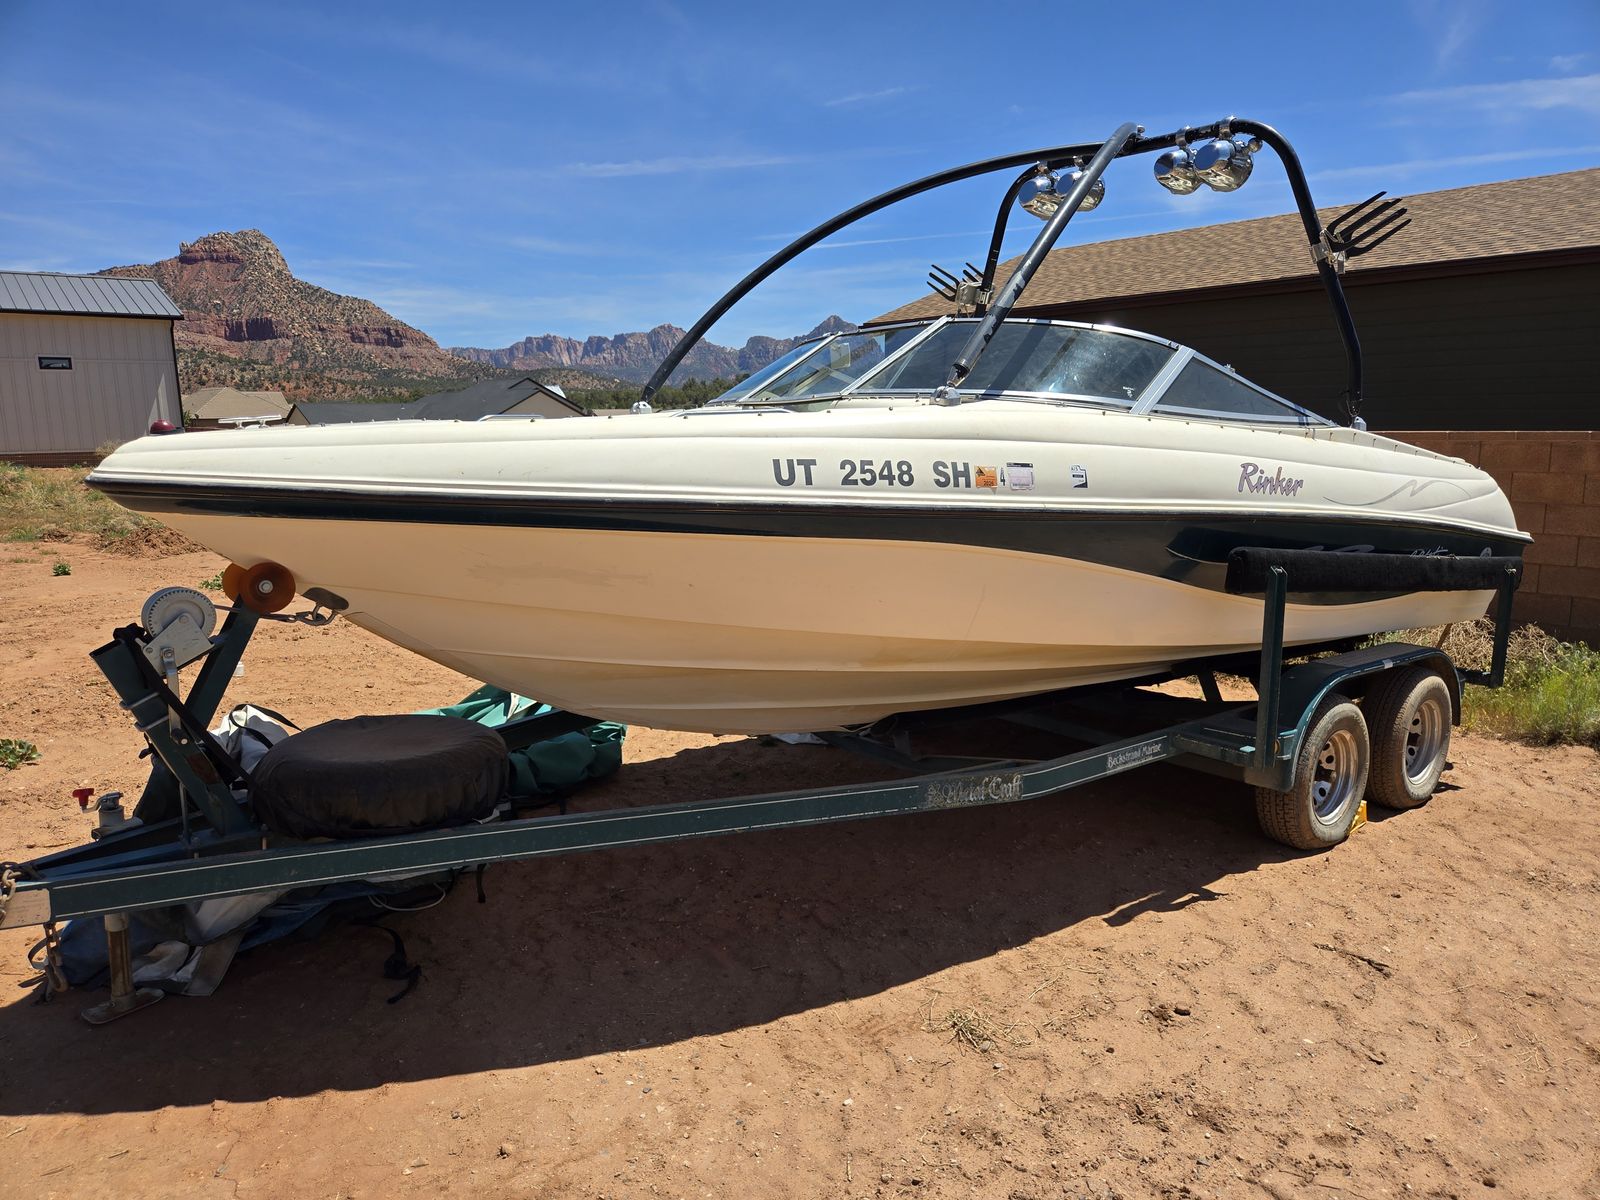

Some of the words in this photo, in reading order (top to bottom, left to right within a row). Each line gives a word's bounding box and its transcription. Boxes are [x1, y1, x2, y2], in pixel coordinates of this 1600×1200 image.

[772, 458, 817, 486] UT
[839, 459, 914, 487] 2548
[933, 460, 972, 488] SH
[1238, 462, 1303, 497] Rinker
